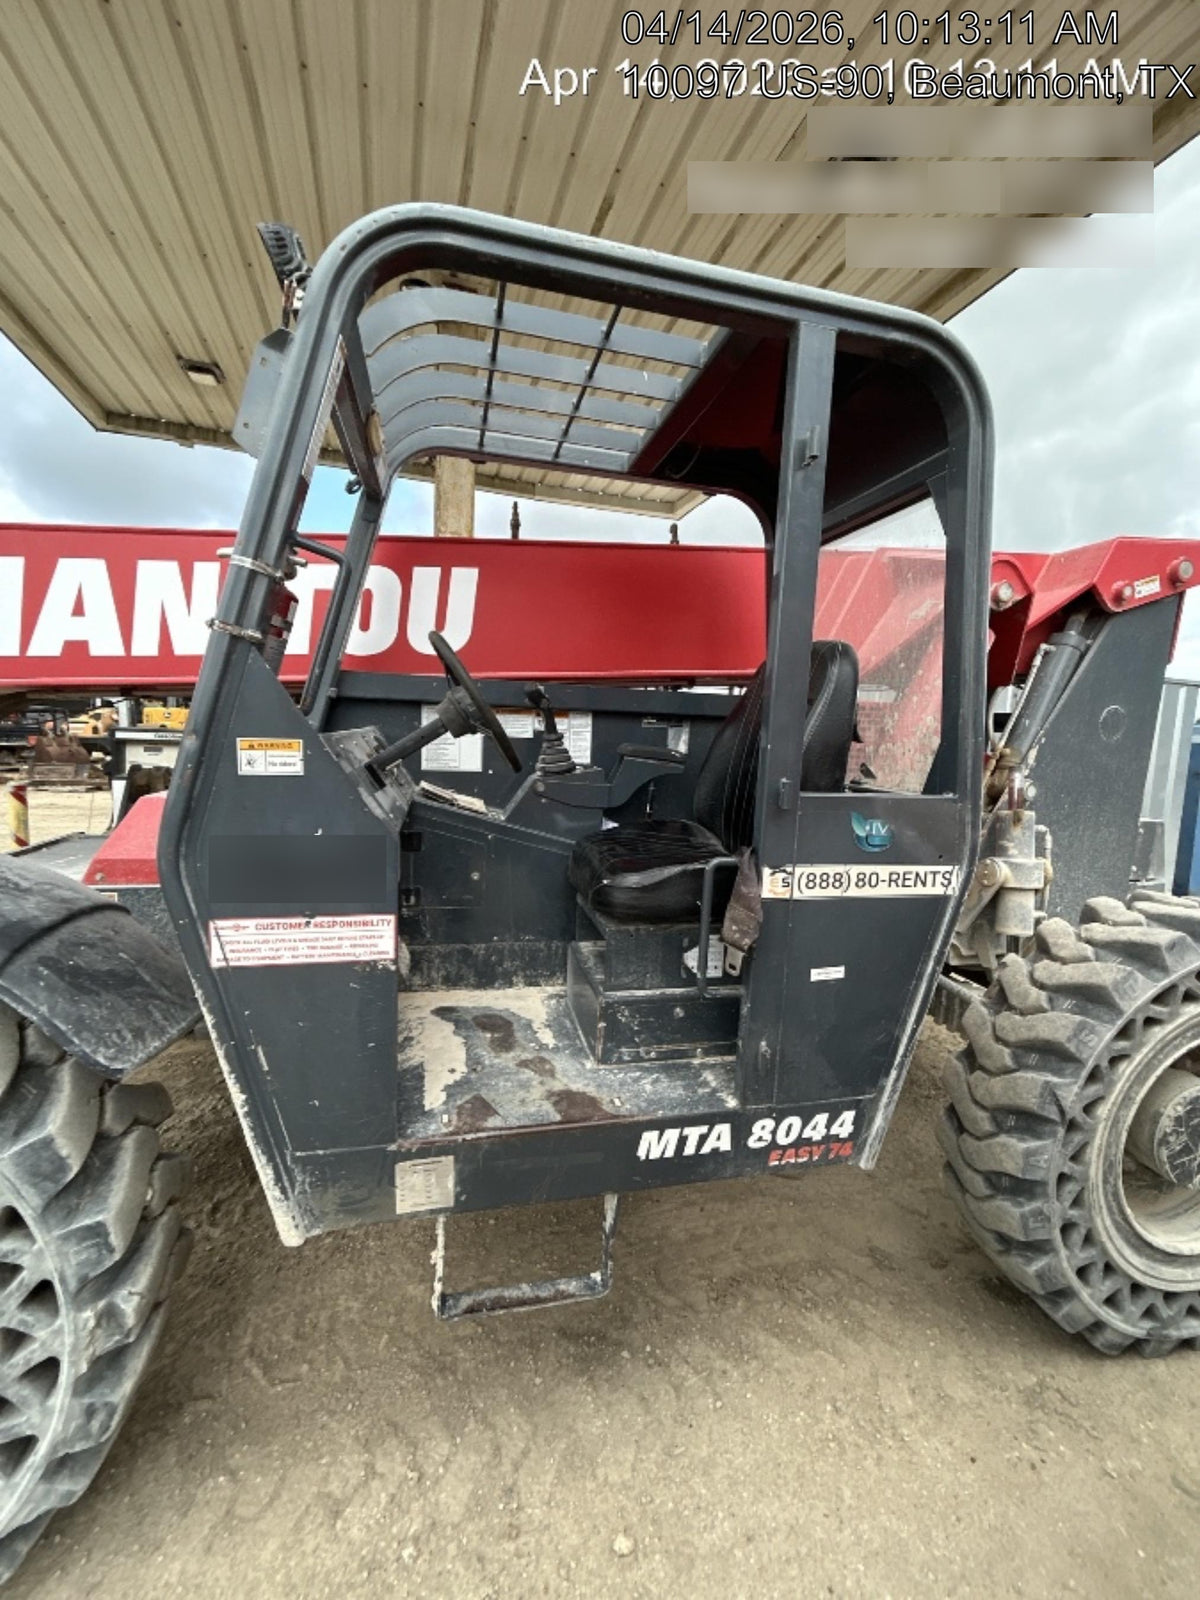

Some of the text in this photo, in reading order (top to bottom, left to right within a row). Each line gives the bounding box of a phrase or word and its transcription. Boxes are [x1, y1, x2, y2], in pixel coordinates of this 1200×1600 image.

[797, 871, 851, 894] (888)
[854, 870, 952, 889] 80-RENTS
[255, 918, 392, 932] CUSTOMER RESPONSIBILITY
[636, 1110, 857, 1161] MTA 8044
[767, 1141, 855, 1166] EASY 74
